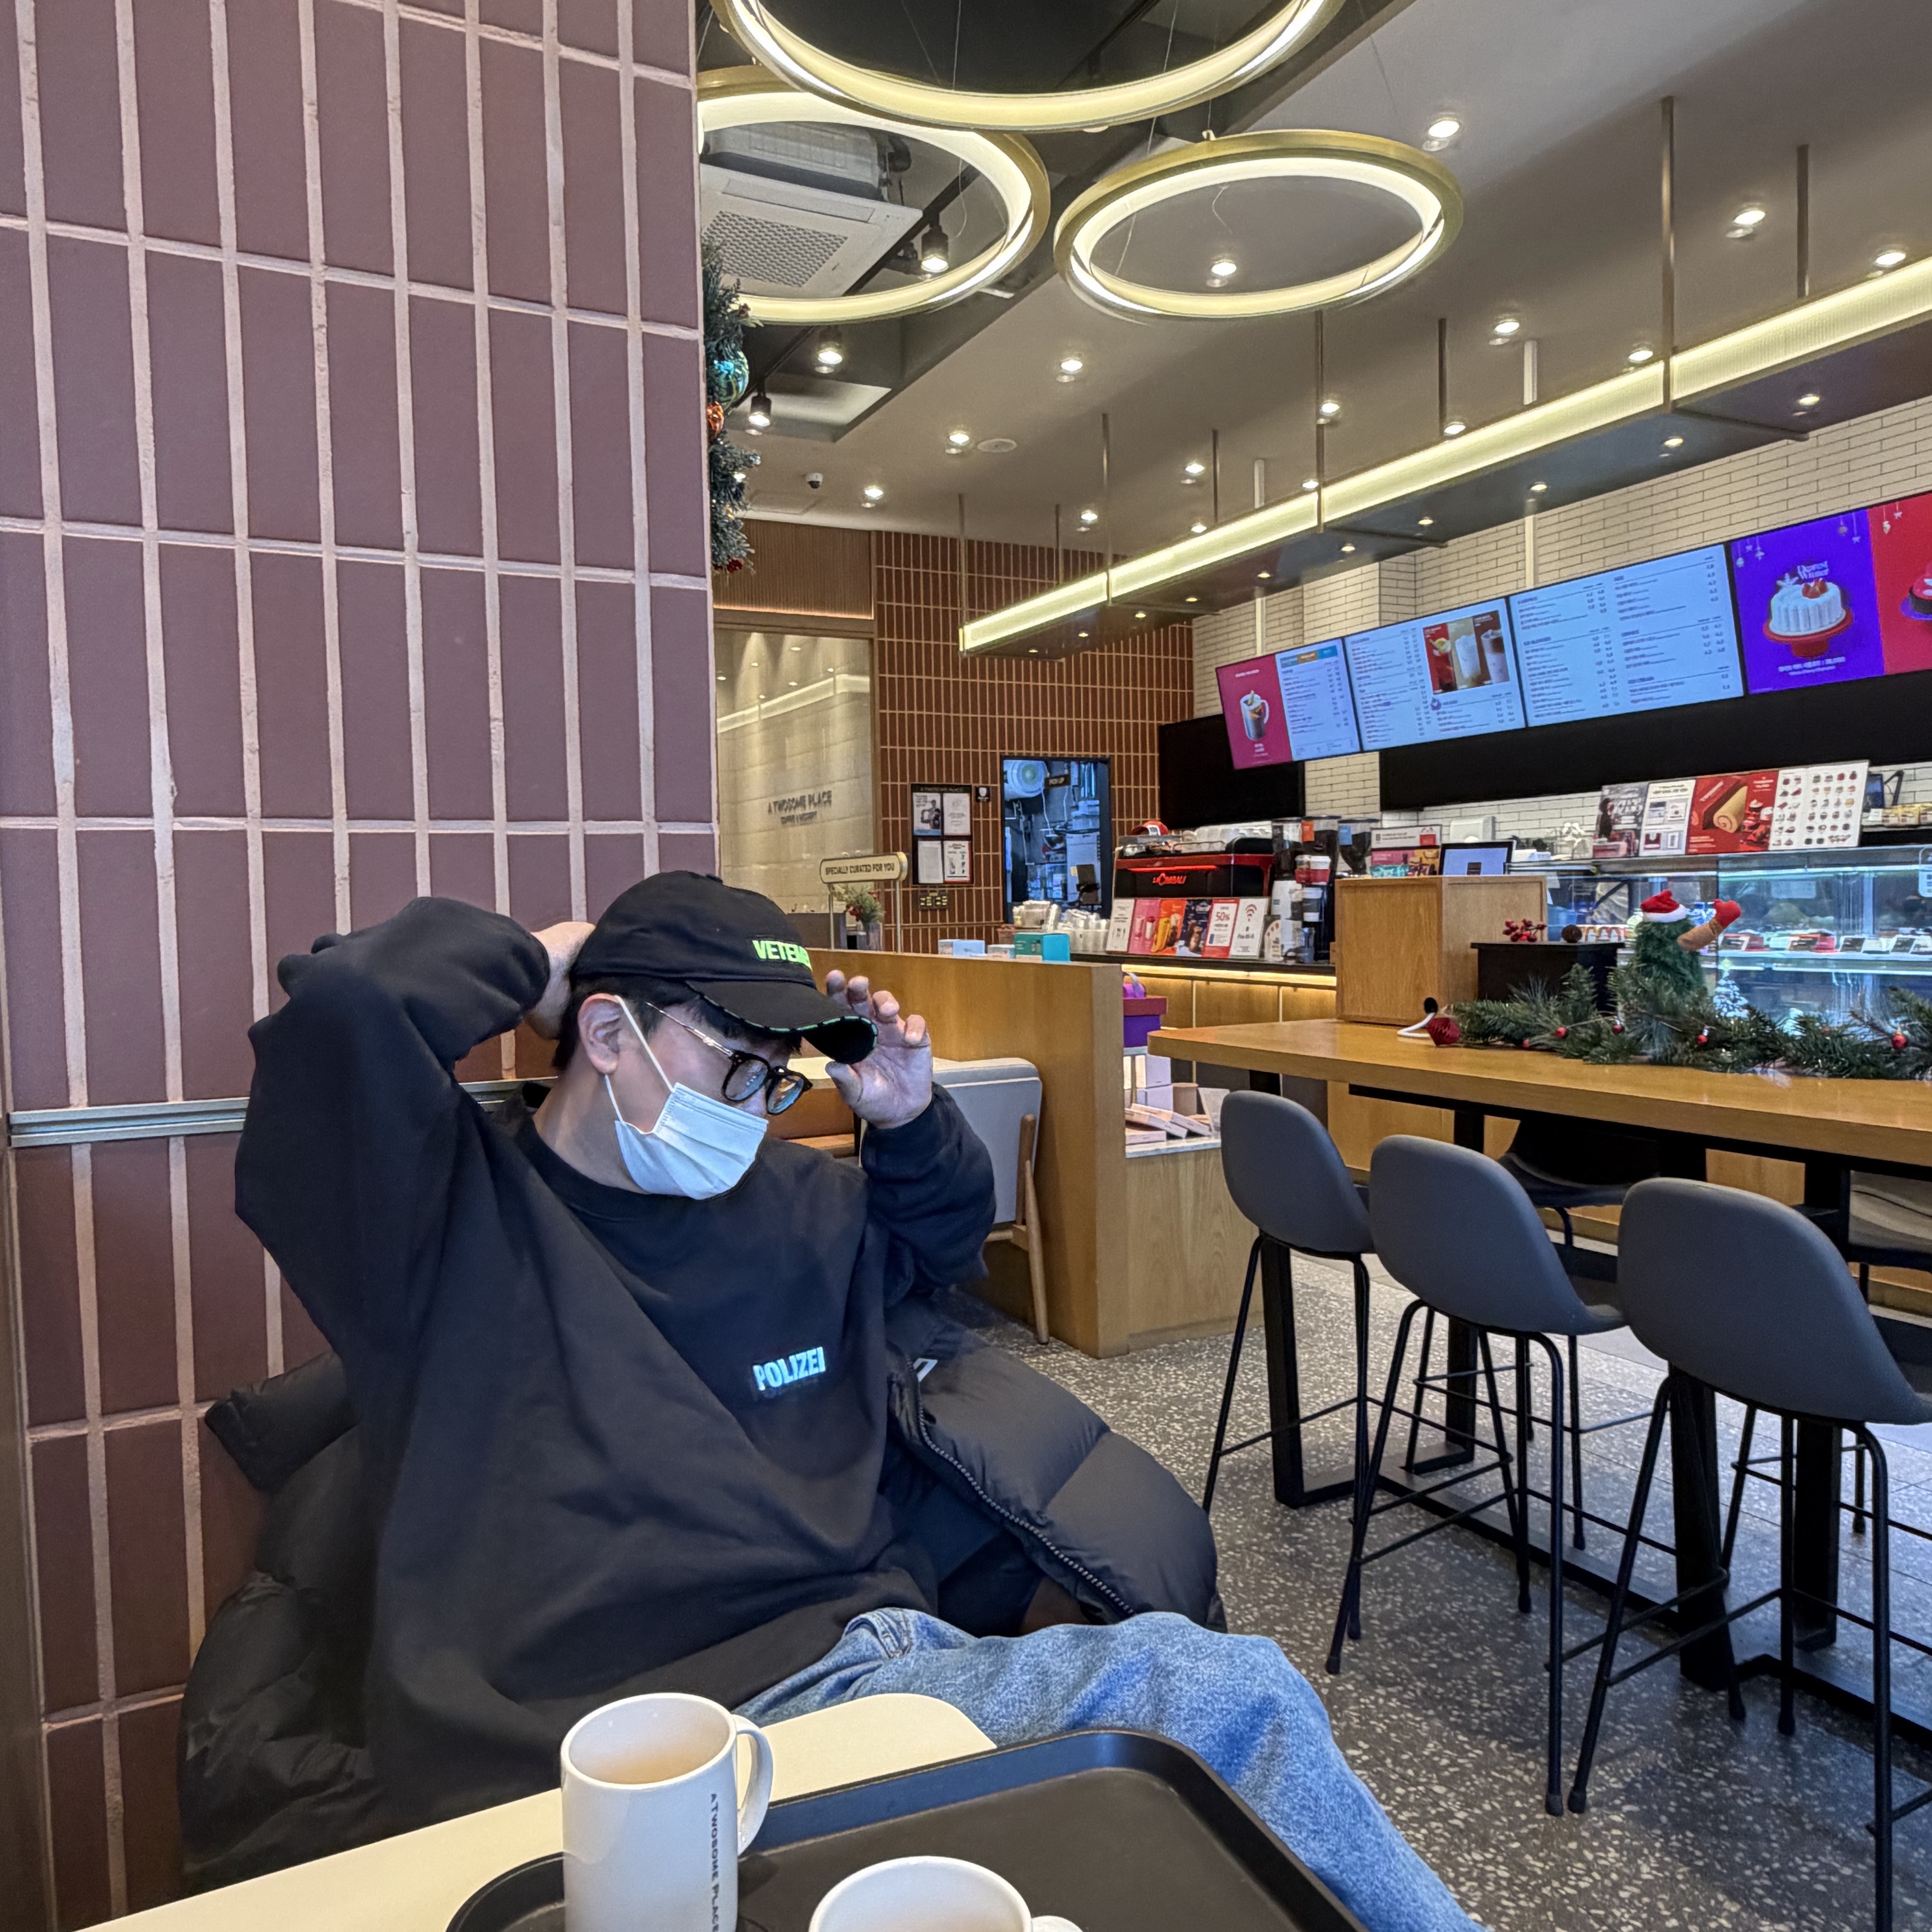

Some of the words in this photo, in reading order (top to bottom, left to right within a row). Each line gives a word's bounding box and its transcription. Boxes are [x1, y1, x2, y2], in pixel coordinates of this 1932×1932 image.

[873, 863, 883, 872] FOR
[884, 862, 895, 872] YOU
[753, 1346, 826, 1391] POLIZEI
[711, 1793, 717, 1803] A
[711, 1802, 719, 1882] TWOSOME
